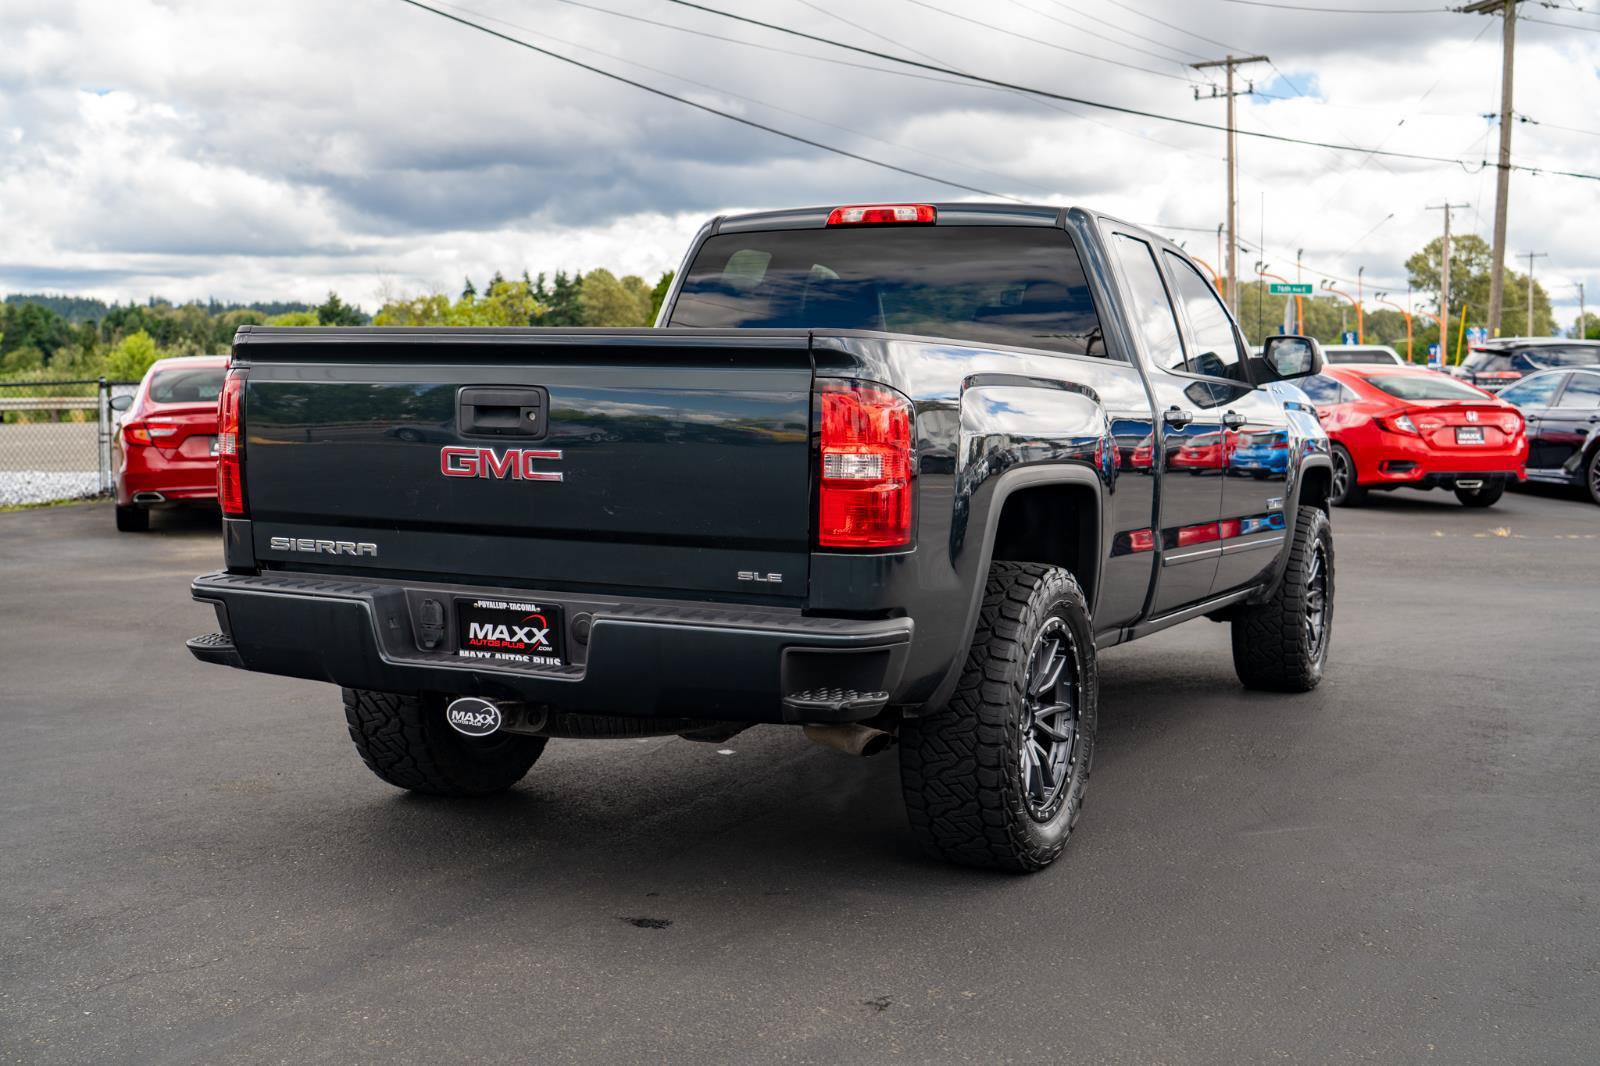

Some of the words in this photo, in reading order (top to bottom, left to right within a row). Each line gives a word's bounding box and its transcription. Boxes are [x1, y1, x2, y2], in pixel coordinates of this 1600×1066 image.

[1458, 432, 1480, 440] MAXX
[441, 446, 563, 481] GMC
[270, 536, 378, 557] SIERRA
[737, 571, 783, 582] SLE
[468, 622, 550, 645] MAXX
[469, 638, 500, 647] AUTOS
[501, 641, 526, 649] PLUS
[452, 710, 496, 725] MAXX
